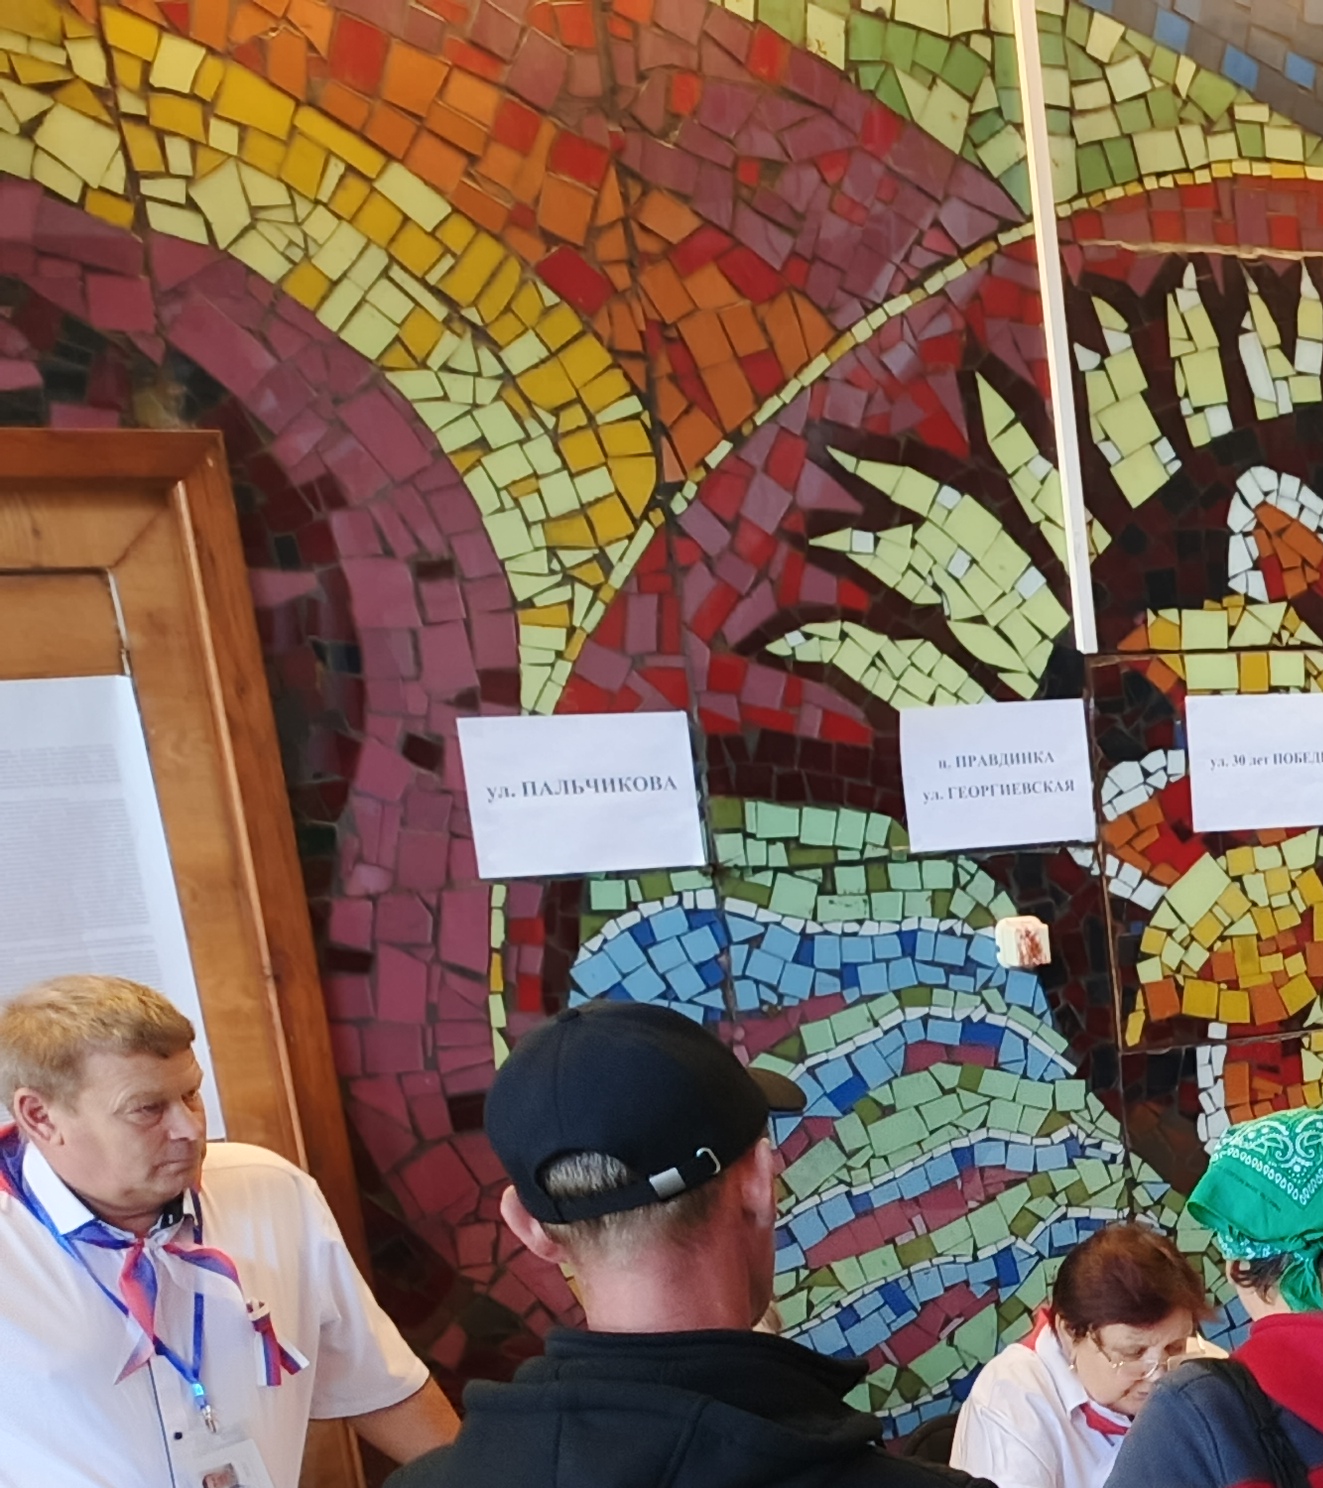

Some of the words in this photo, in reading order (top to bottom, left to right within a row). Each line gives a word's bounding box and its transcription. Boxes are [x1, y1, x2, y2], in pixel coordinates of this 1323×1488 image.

[955, 750, 1055, 768] ПРАВДИНКА
[1210, 758, 1229, 771] ул.
[1232, 754, 1246, 767] 30
[1249, 756, 1269, 766] лет
[486, 786, 516, 803] ул.
[522, 775, 678, 797] ПАЛЬЧИКОВА
[922, 791, 945, 805] ул.
[947, 779, 1075, 800] ГЕОРГИЕВСКАЯ
